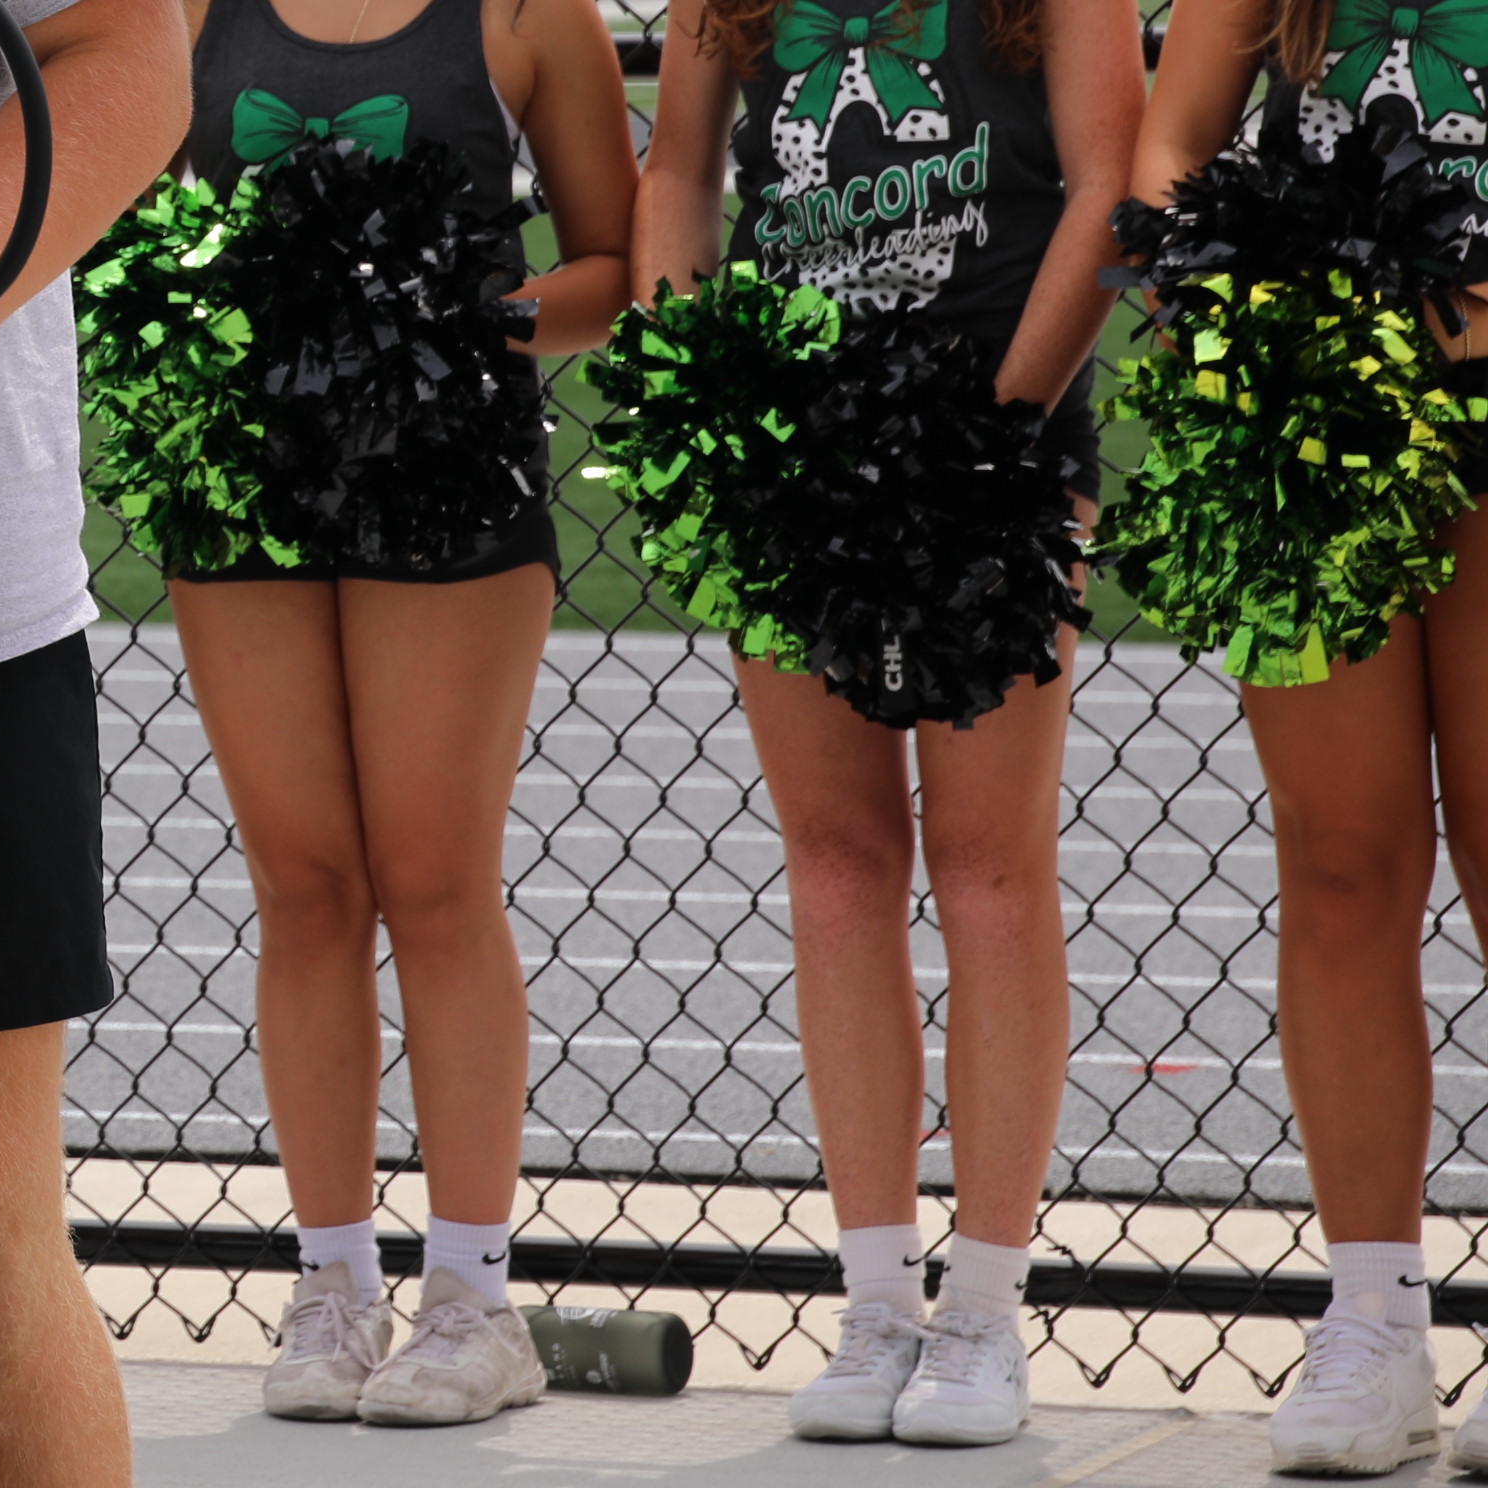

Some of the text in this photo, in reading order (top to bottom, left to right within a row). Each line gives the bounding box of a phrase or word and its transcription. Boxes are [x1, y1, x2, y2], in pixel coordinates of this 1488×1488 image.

[754, 121, 990, 247] Concord
[761, 199, 989, 283] Cheerleading
[881, 618, 904, 692] CHL
